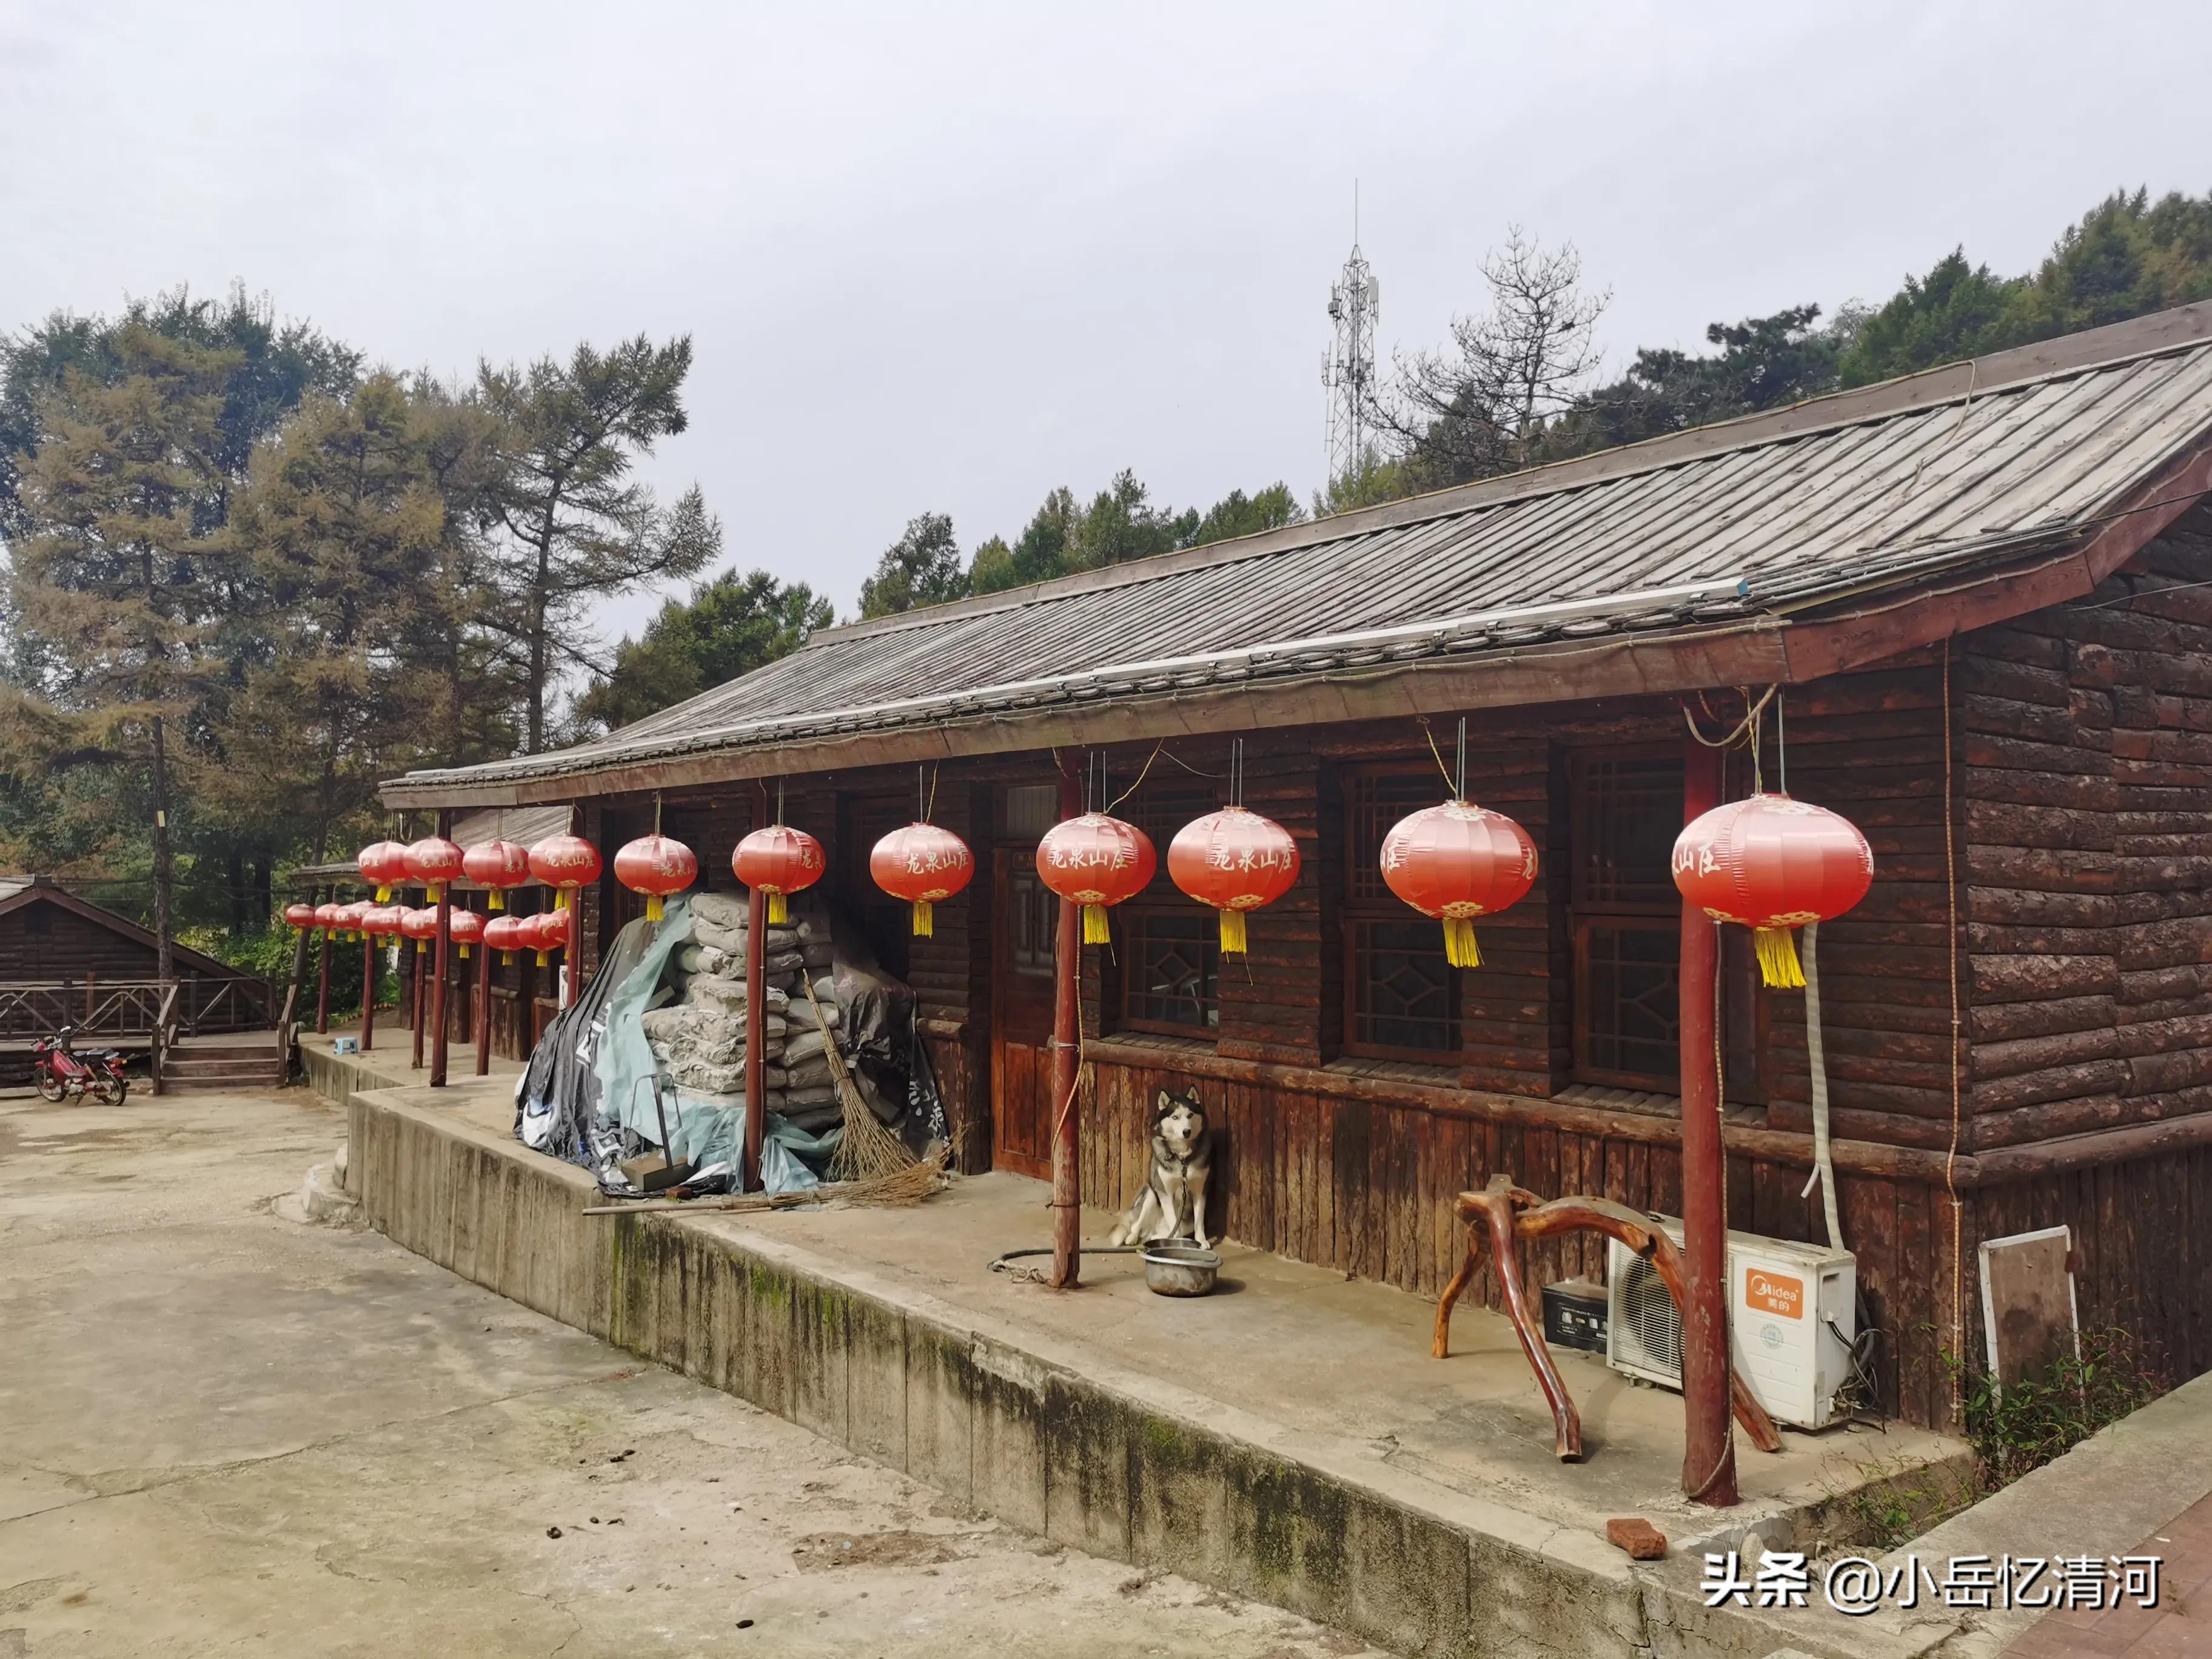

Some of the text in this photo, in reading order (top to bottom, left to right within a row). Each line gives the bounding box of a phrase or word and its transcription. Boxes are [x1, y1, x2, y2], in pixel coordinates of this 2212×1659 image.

[546, 851, 594, 869] 龙泉山庄
[907, 850, 969, 874] 龙泉山庄
[1052, 848, 1128, 871] 龙泉山庄
[1214, 845, 1292, 873] 龙泉山庄
[1751, 1275, 1797, 1301] Midea
